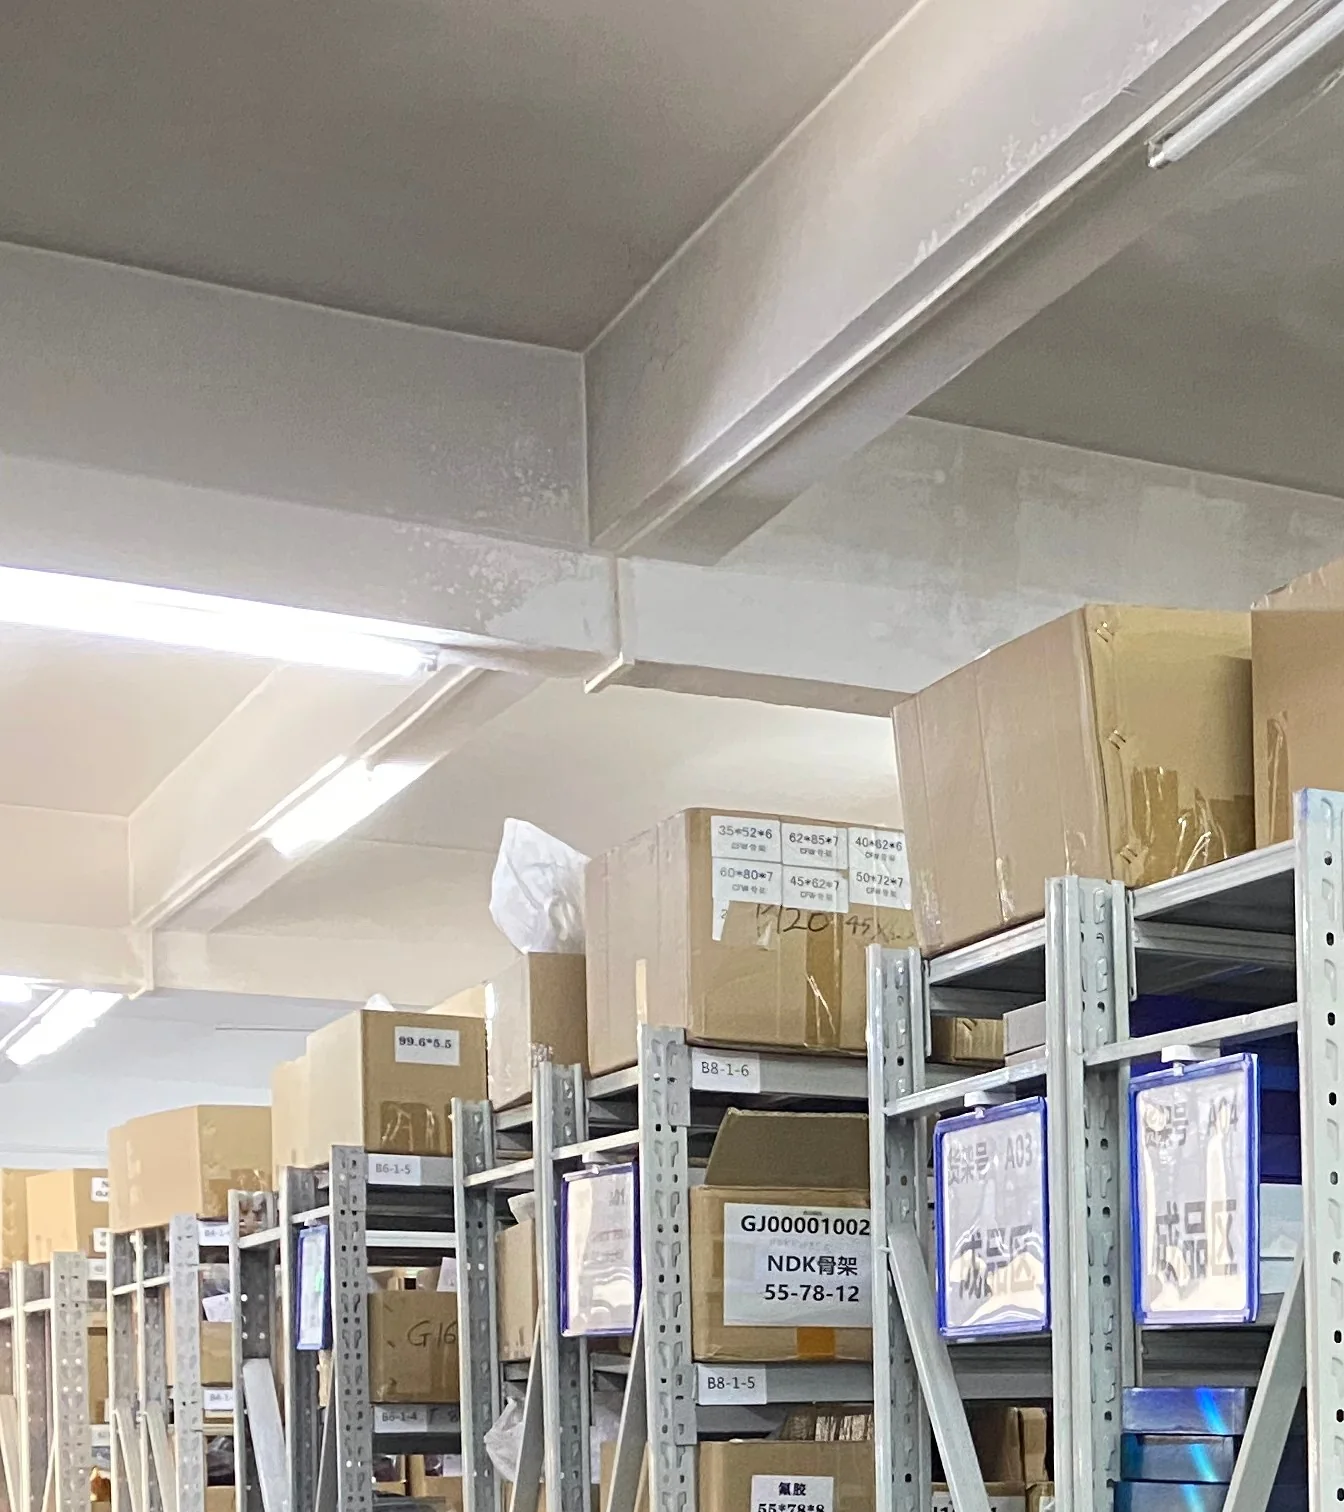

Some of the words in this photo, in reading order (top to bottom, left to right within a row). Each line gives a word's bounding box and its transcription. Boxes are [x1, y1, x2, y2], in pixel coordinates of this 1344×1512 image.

[701, 1061, 750, 1077] B8-1-6
[1005, 1132, 1034, 1171] A03
[741, 1215, 870, 1236] GJ00001002
[768, 1255, 858, 1276] NDK骨架
[764, 1284, 860, 1302] 55-78-12
[707, 1376, 755, 1390] B8-1-5
